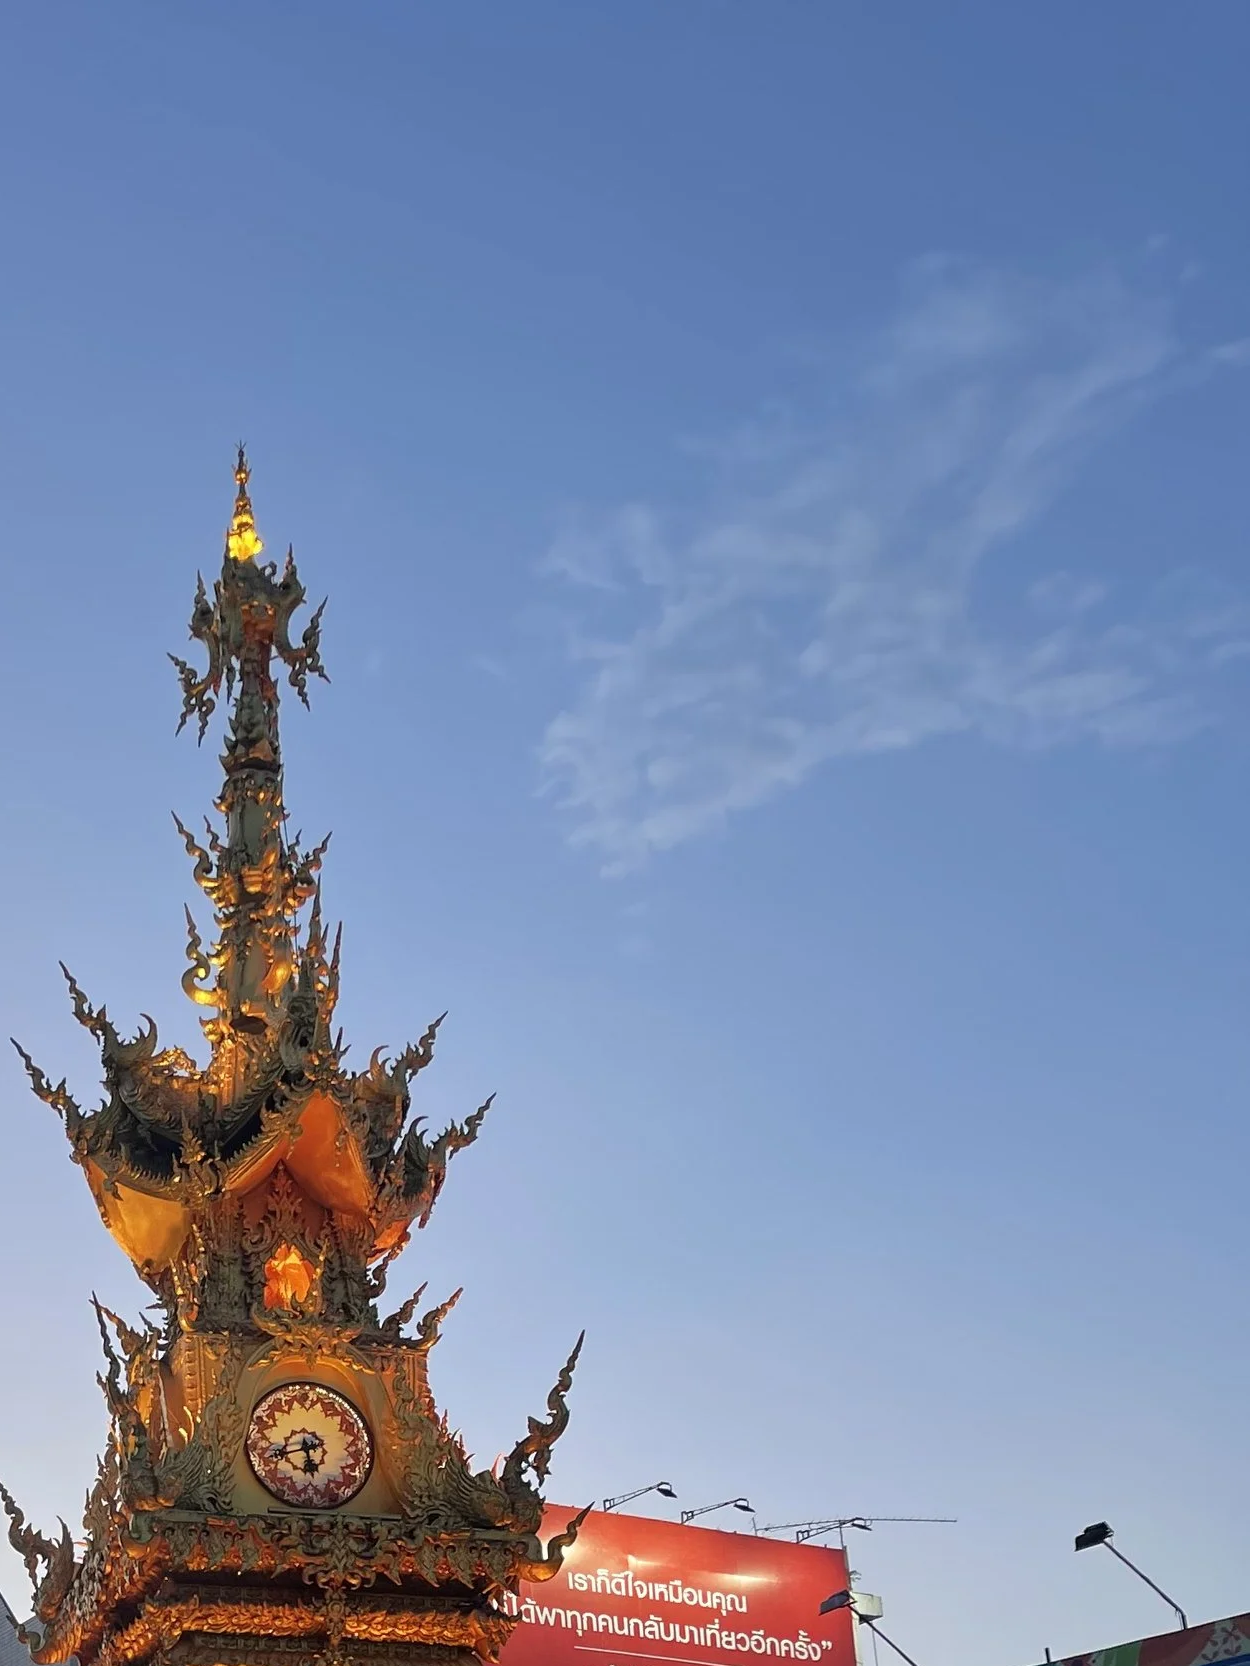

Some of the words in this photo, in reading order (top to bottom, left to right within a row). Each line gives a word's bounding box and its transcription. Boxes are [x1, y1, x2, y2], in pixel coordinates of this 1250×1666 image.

[567, 1567, 748, 1617] เราก็ดีใจเหมือนคุณ
